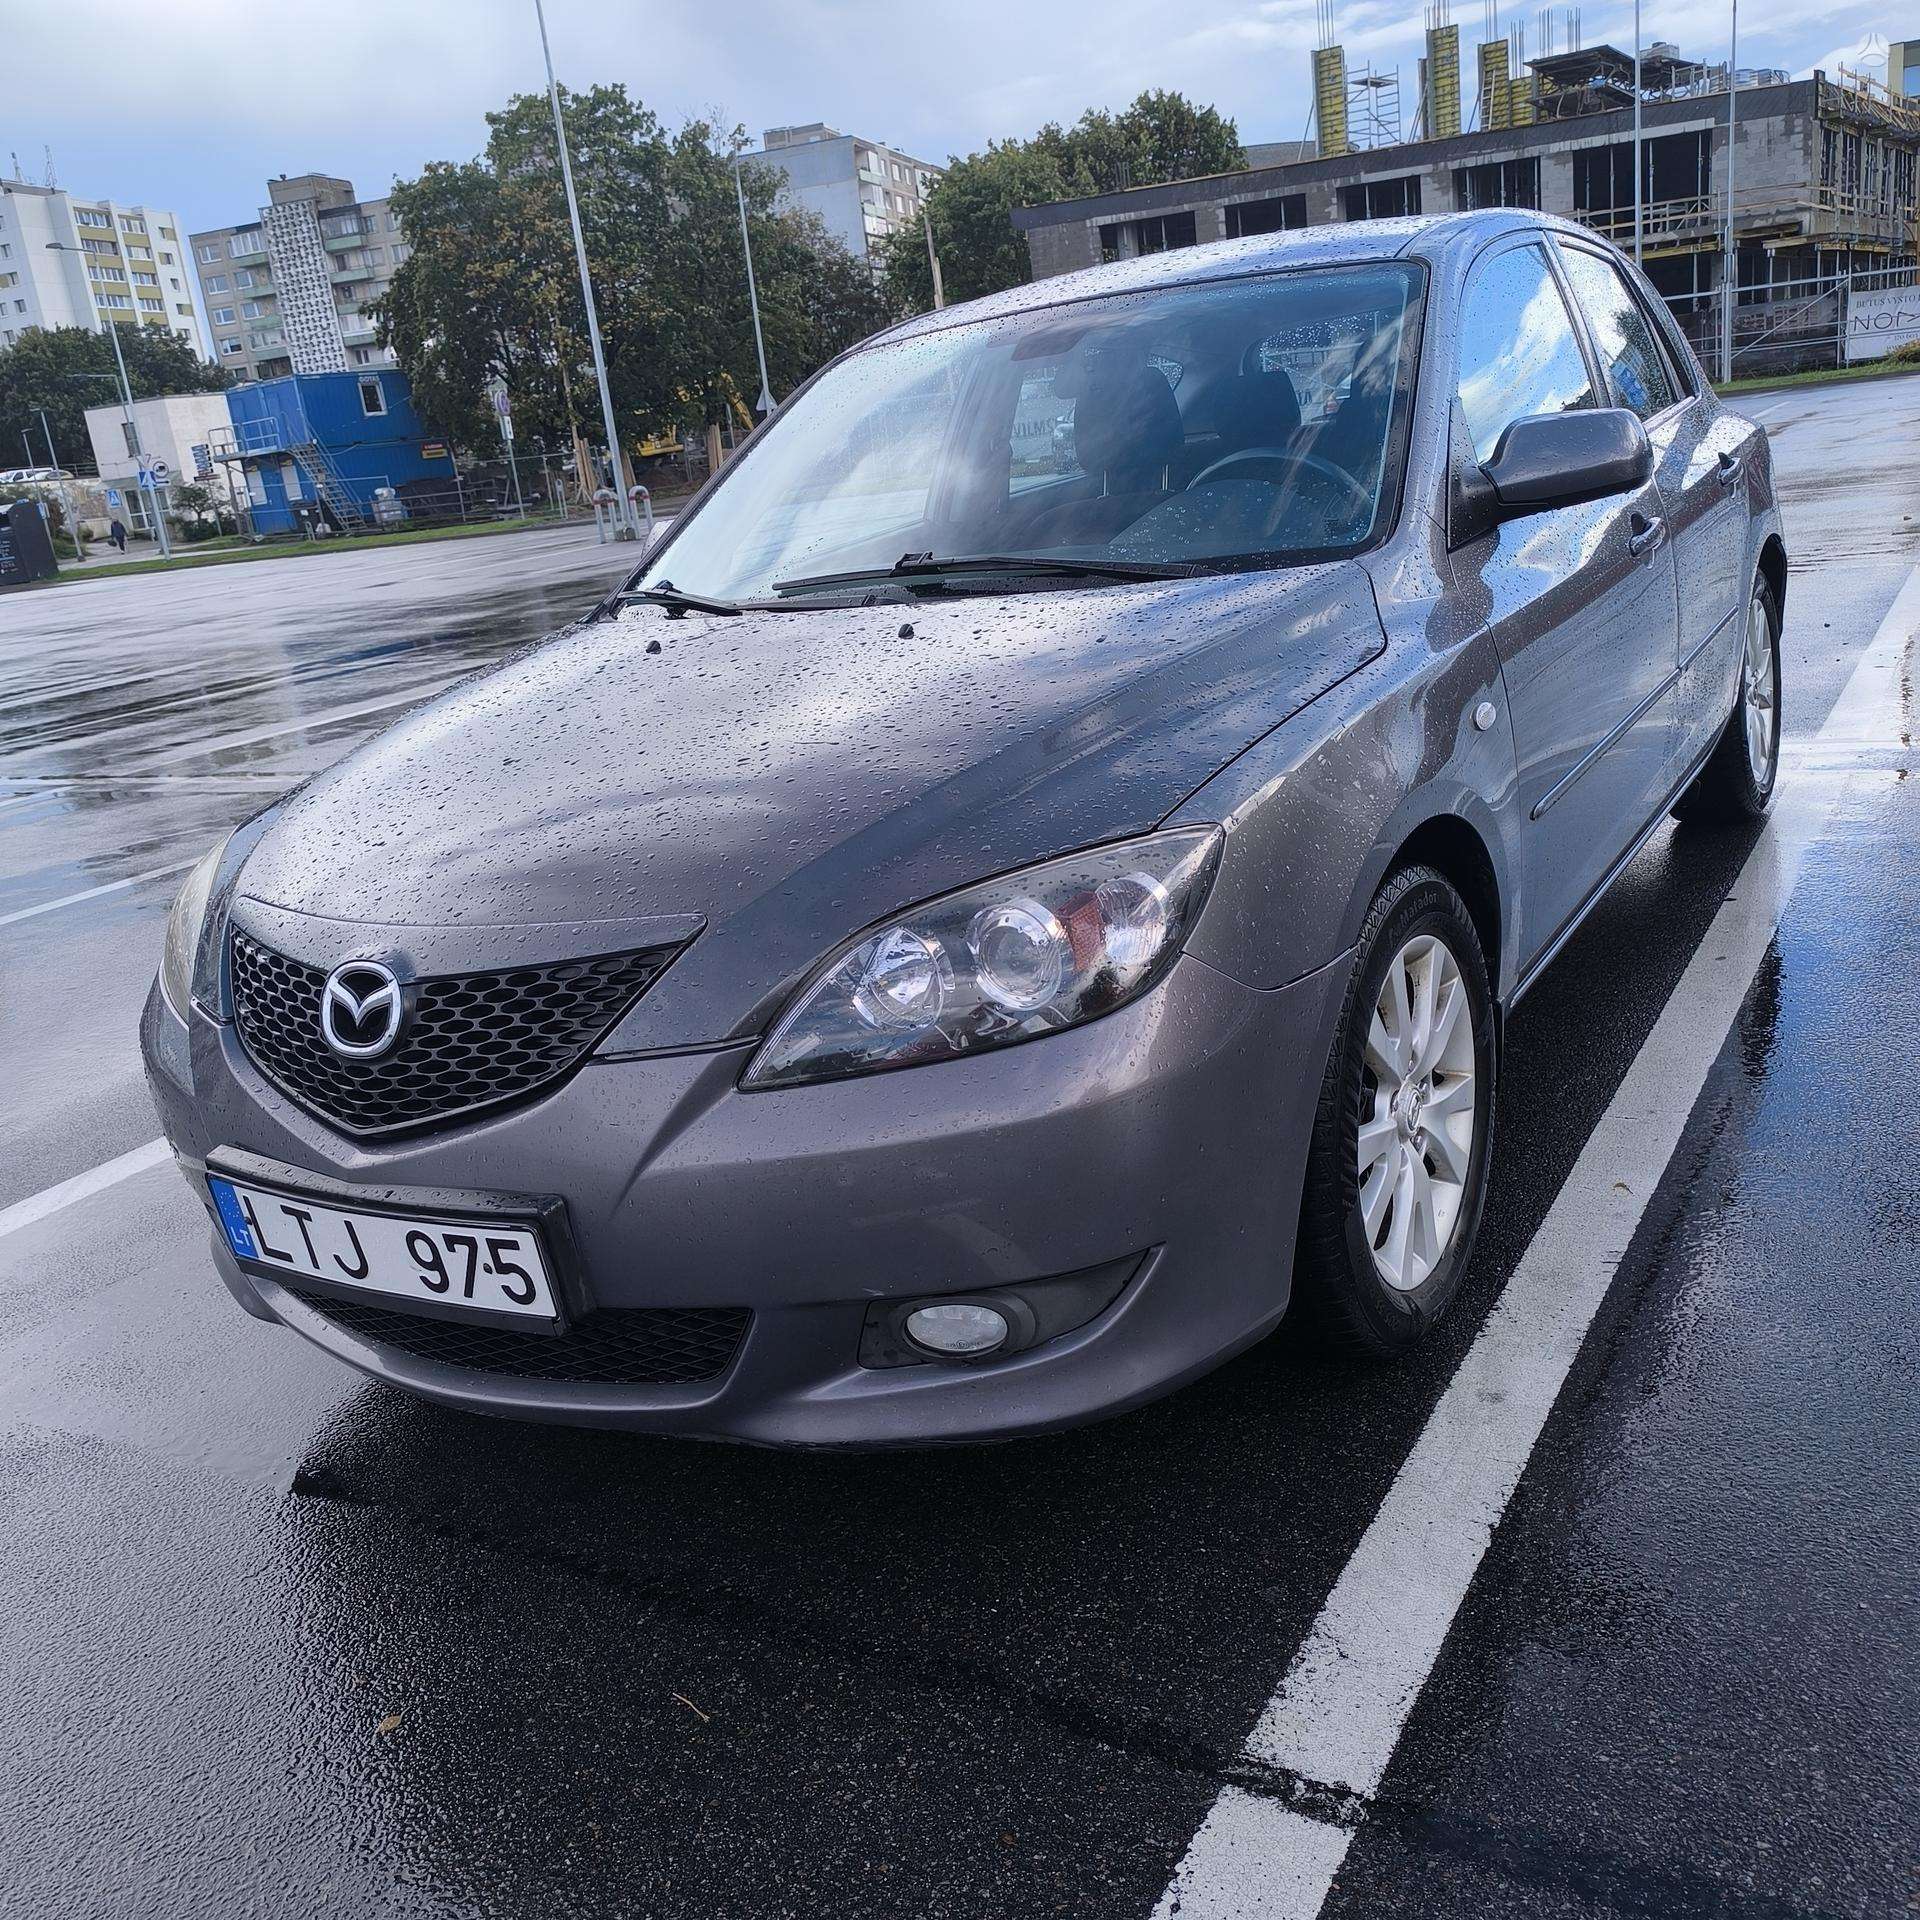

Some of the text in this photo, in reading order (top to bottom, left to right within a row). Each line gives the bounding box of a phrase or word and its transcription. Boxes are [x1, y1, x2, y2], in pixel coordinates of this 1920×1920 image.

[231, 1226, 250, 1247] LT
[242, 1195, 537, 1305] LTJ 975
